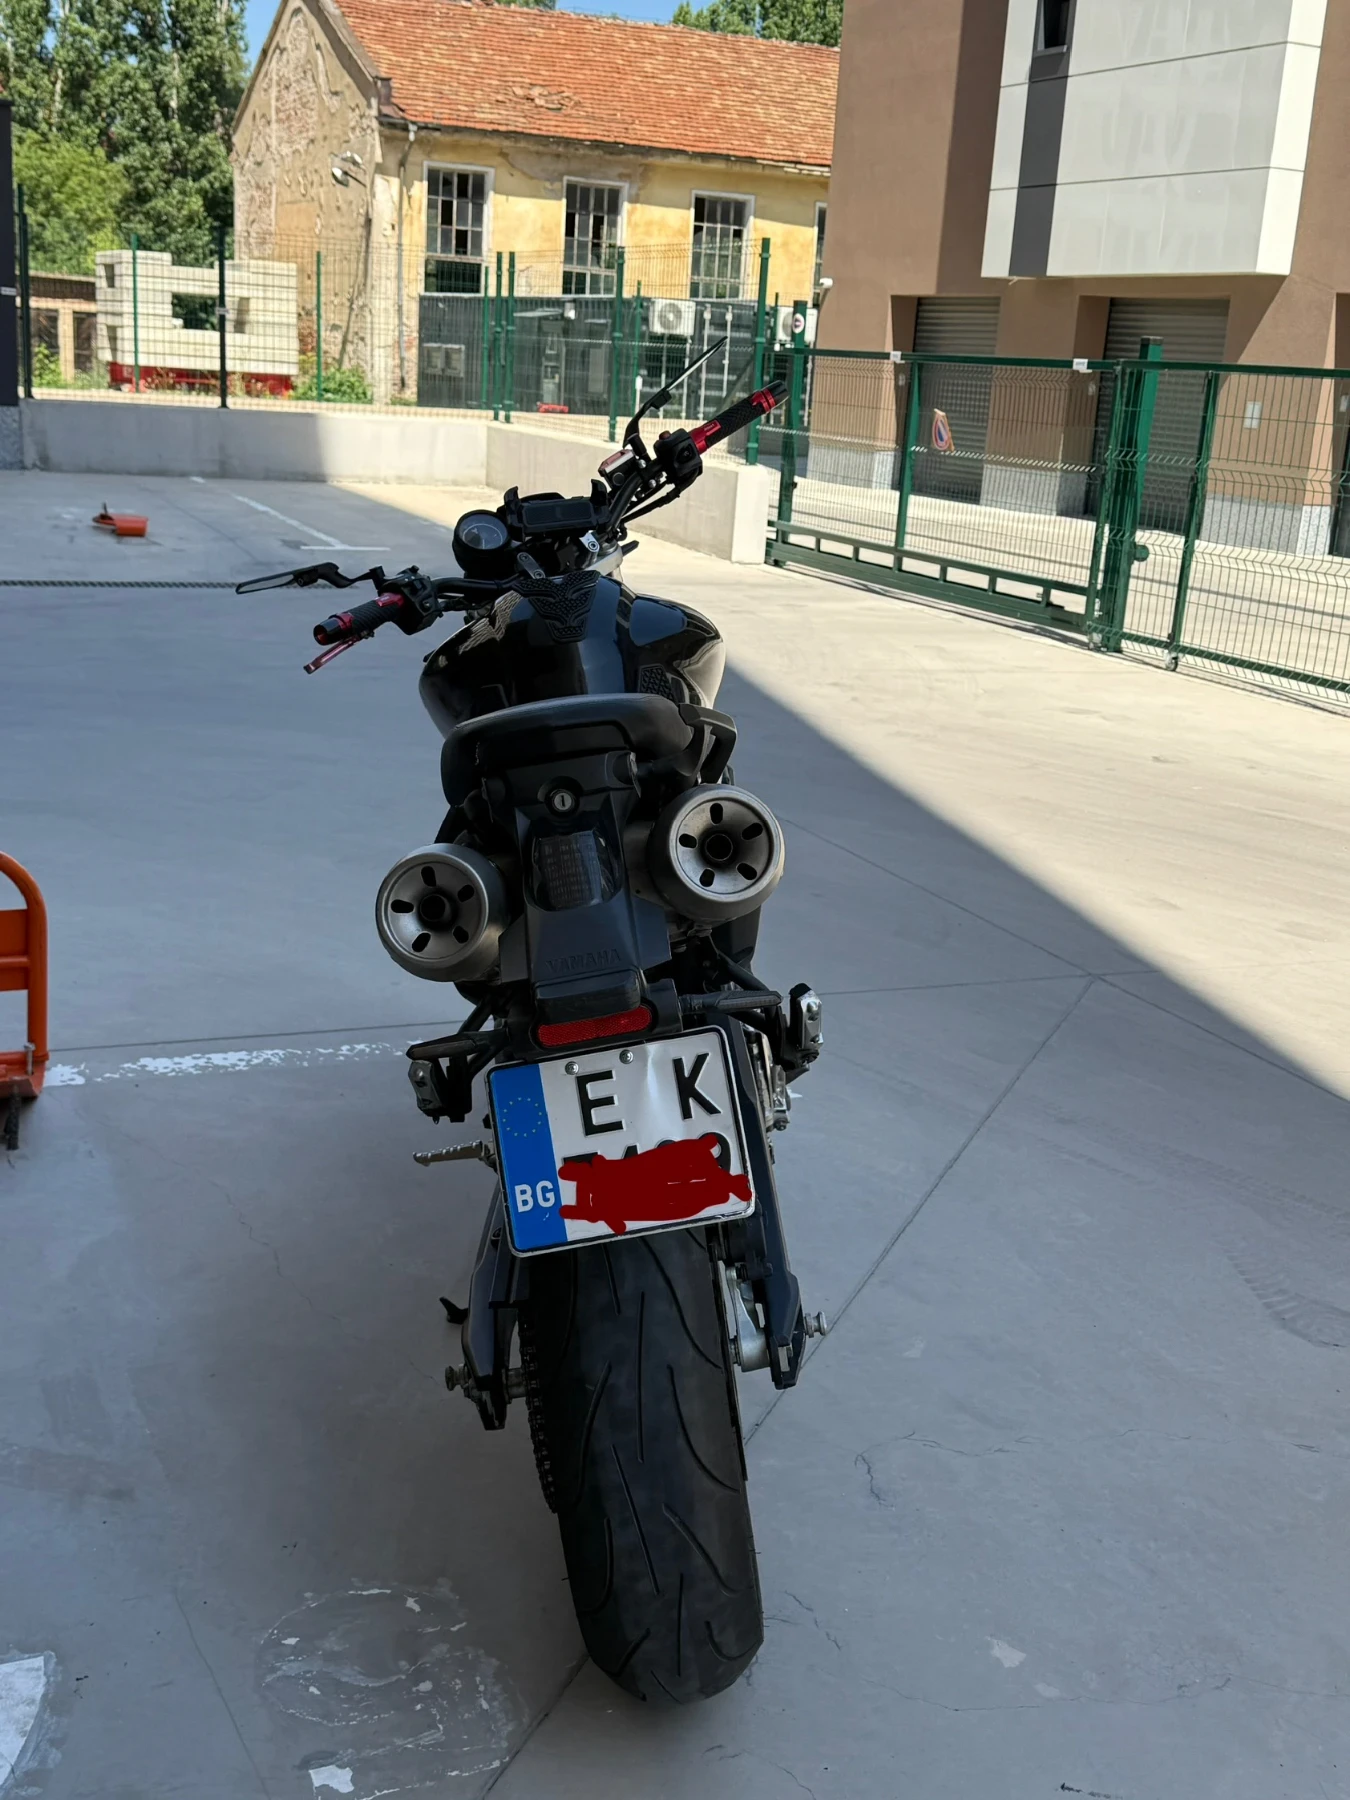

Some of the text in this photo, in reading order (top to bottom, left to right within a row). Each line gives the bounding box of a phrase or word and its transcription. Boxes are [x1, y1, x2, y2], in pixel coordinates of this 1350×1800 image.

[545, 948, 621, 973] YAMAHA
[576, 1052, 722, 1136] E K
[514, 1180, 556, 1213] BG
